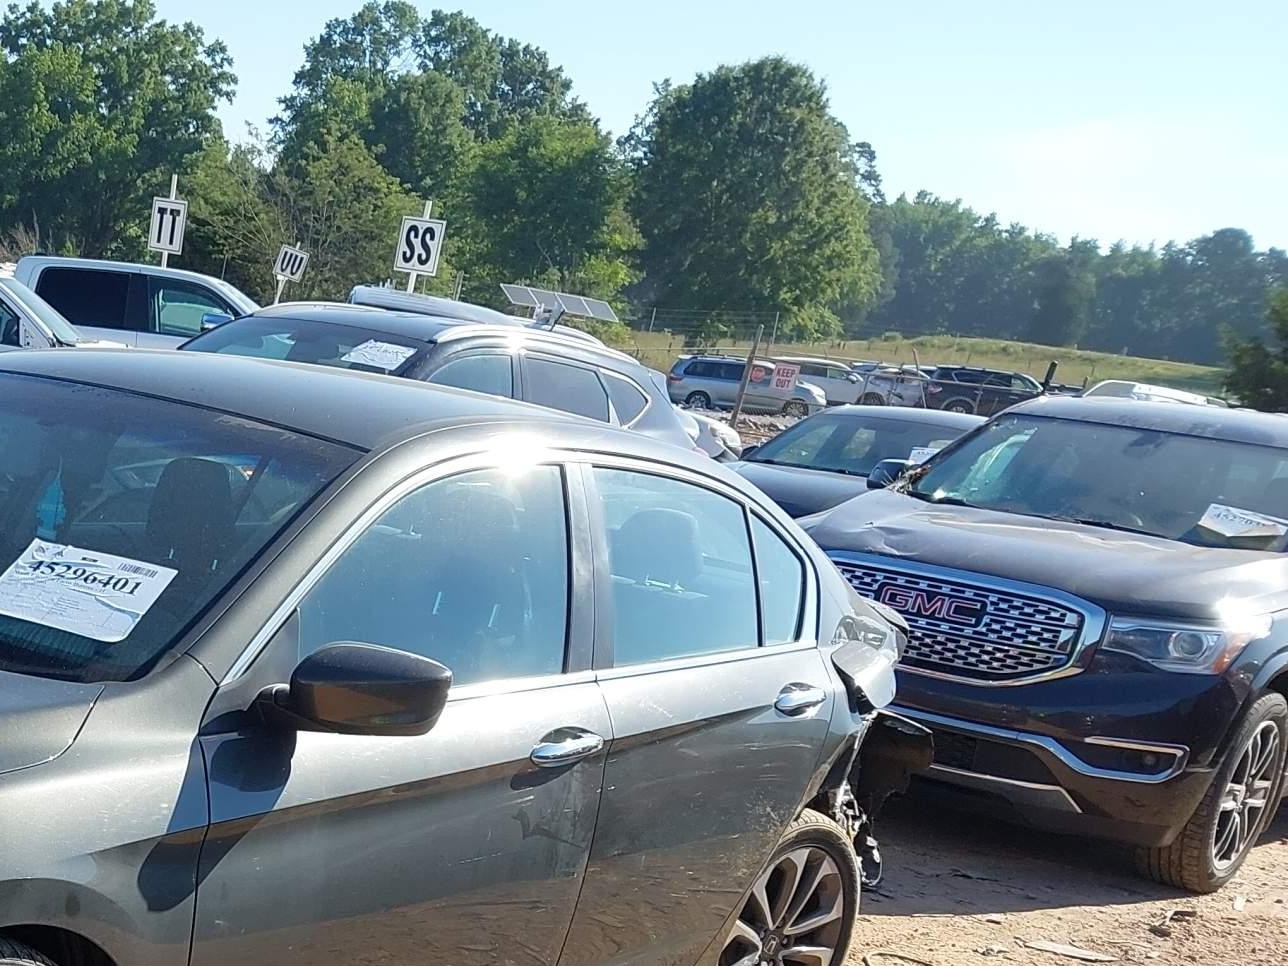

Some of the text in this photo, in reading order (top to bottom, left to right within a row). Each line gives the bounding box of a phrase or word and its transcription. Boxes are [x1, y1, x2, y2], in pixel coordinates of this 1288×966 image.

[157, 206, 181, 245] TT
[281, 250, 304, 276] UU
[402, 224, 436, 266] SS
[775, 367, 796, 378] KEEP
[775, 378, 791, 388] OUT
[28, 560, 143, 596] 45296401
[880, 586, 981, 624] GMC
